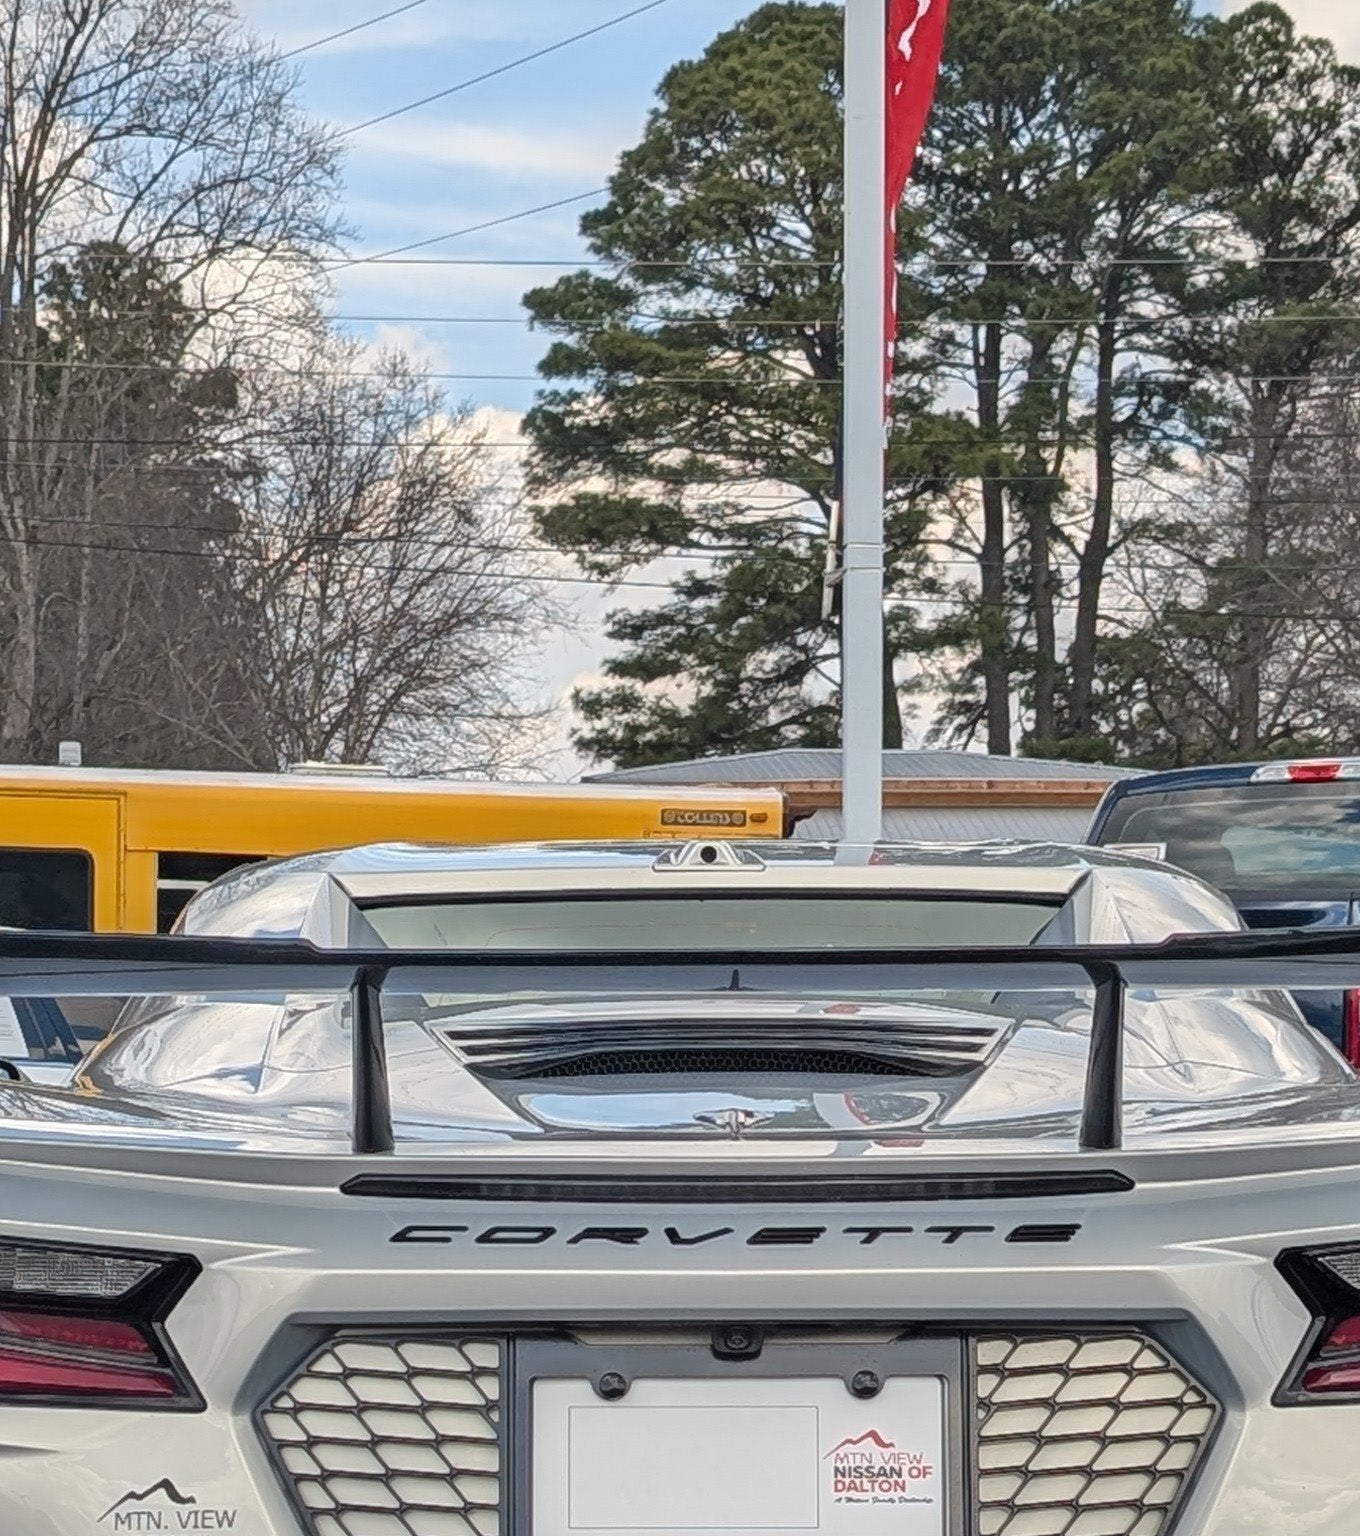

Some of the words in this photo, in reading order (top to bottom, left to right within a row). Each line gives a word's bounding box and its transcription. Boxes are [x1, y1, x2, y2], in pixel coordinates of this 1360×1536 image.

[389, 1222, 1083, 1246] CORVETTE
[880, 1452, 923, 1465] VIEW
[833, 1466, 903, 1479] NISSAN
[907, 1466, 933, 1479] OF
[833, 1480, 907, 1493] DALTON
[114, 1511, 169, 1531] MTN.
[176, 1509, 237, 1529] VIEW
